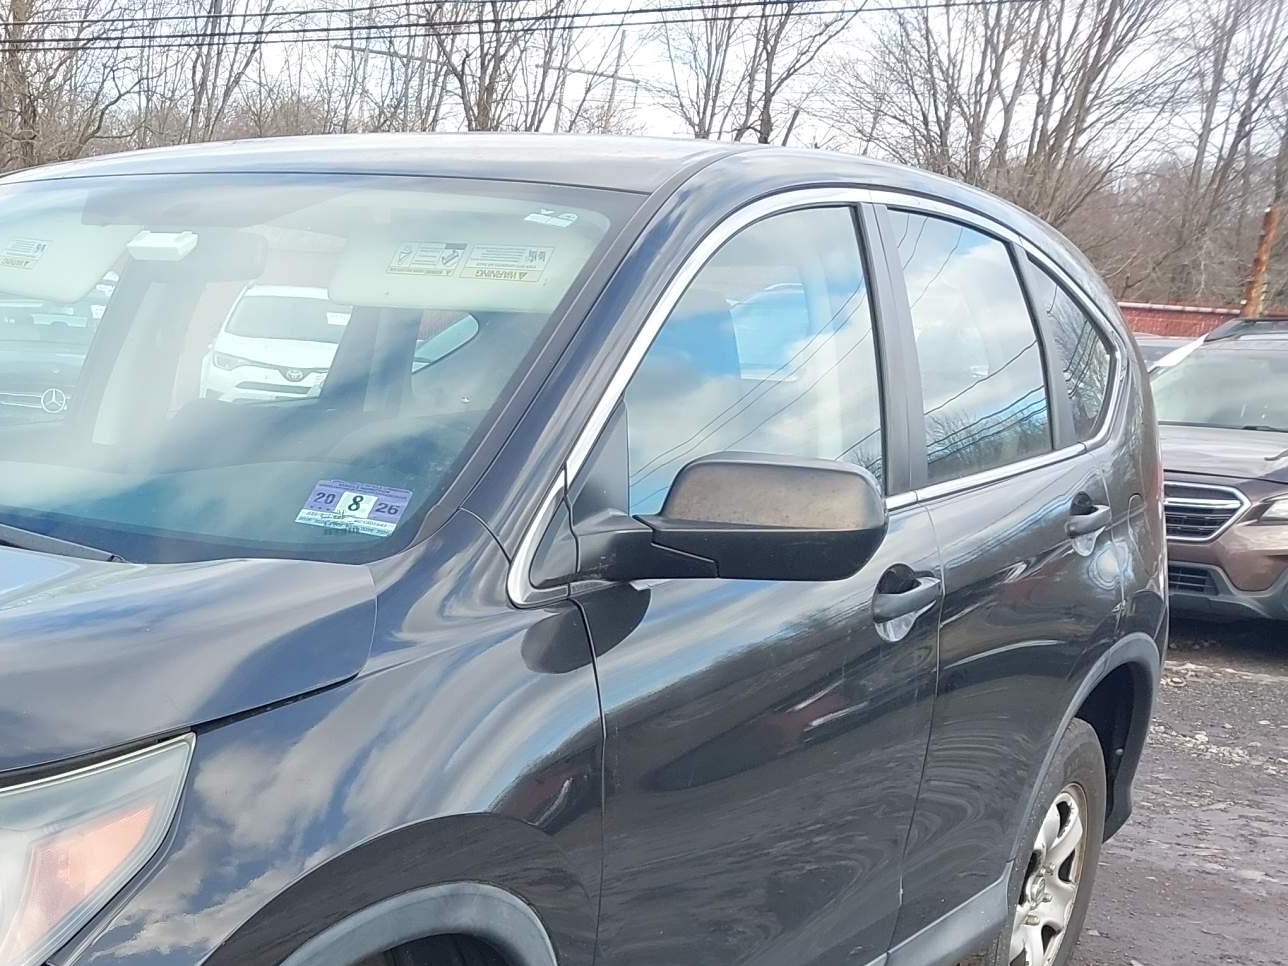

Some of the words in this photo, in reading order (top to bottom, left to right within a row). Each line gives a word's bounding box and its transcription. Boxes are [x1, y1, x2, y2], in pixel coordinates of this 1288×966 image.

[313, 492, 336, 505] 20
[347, 495, 364, 511] 8
[375, 503, 400, 515] 26
